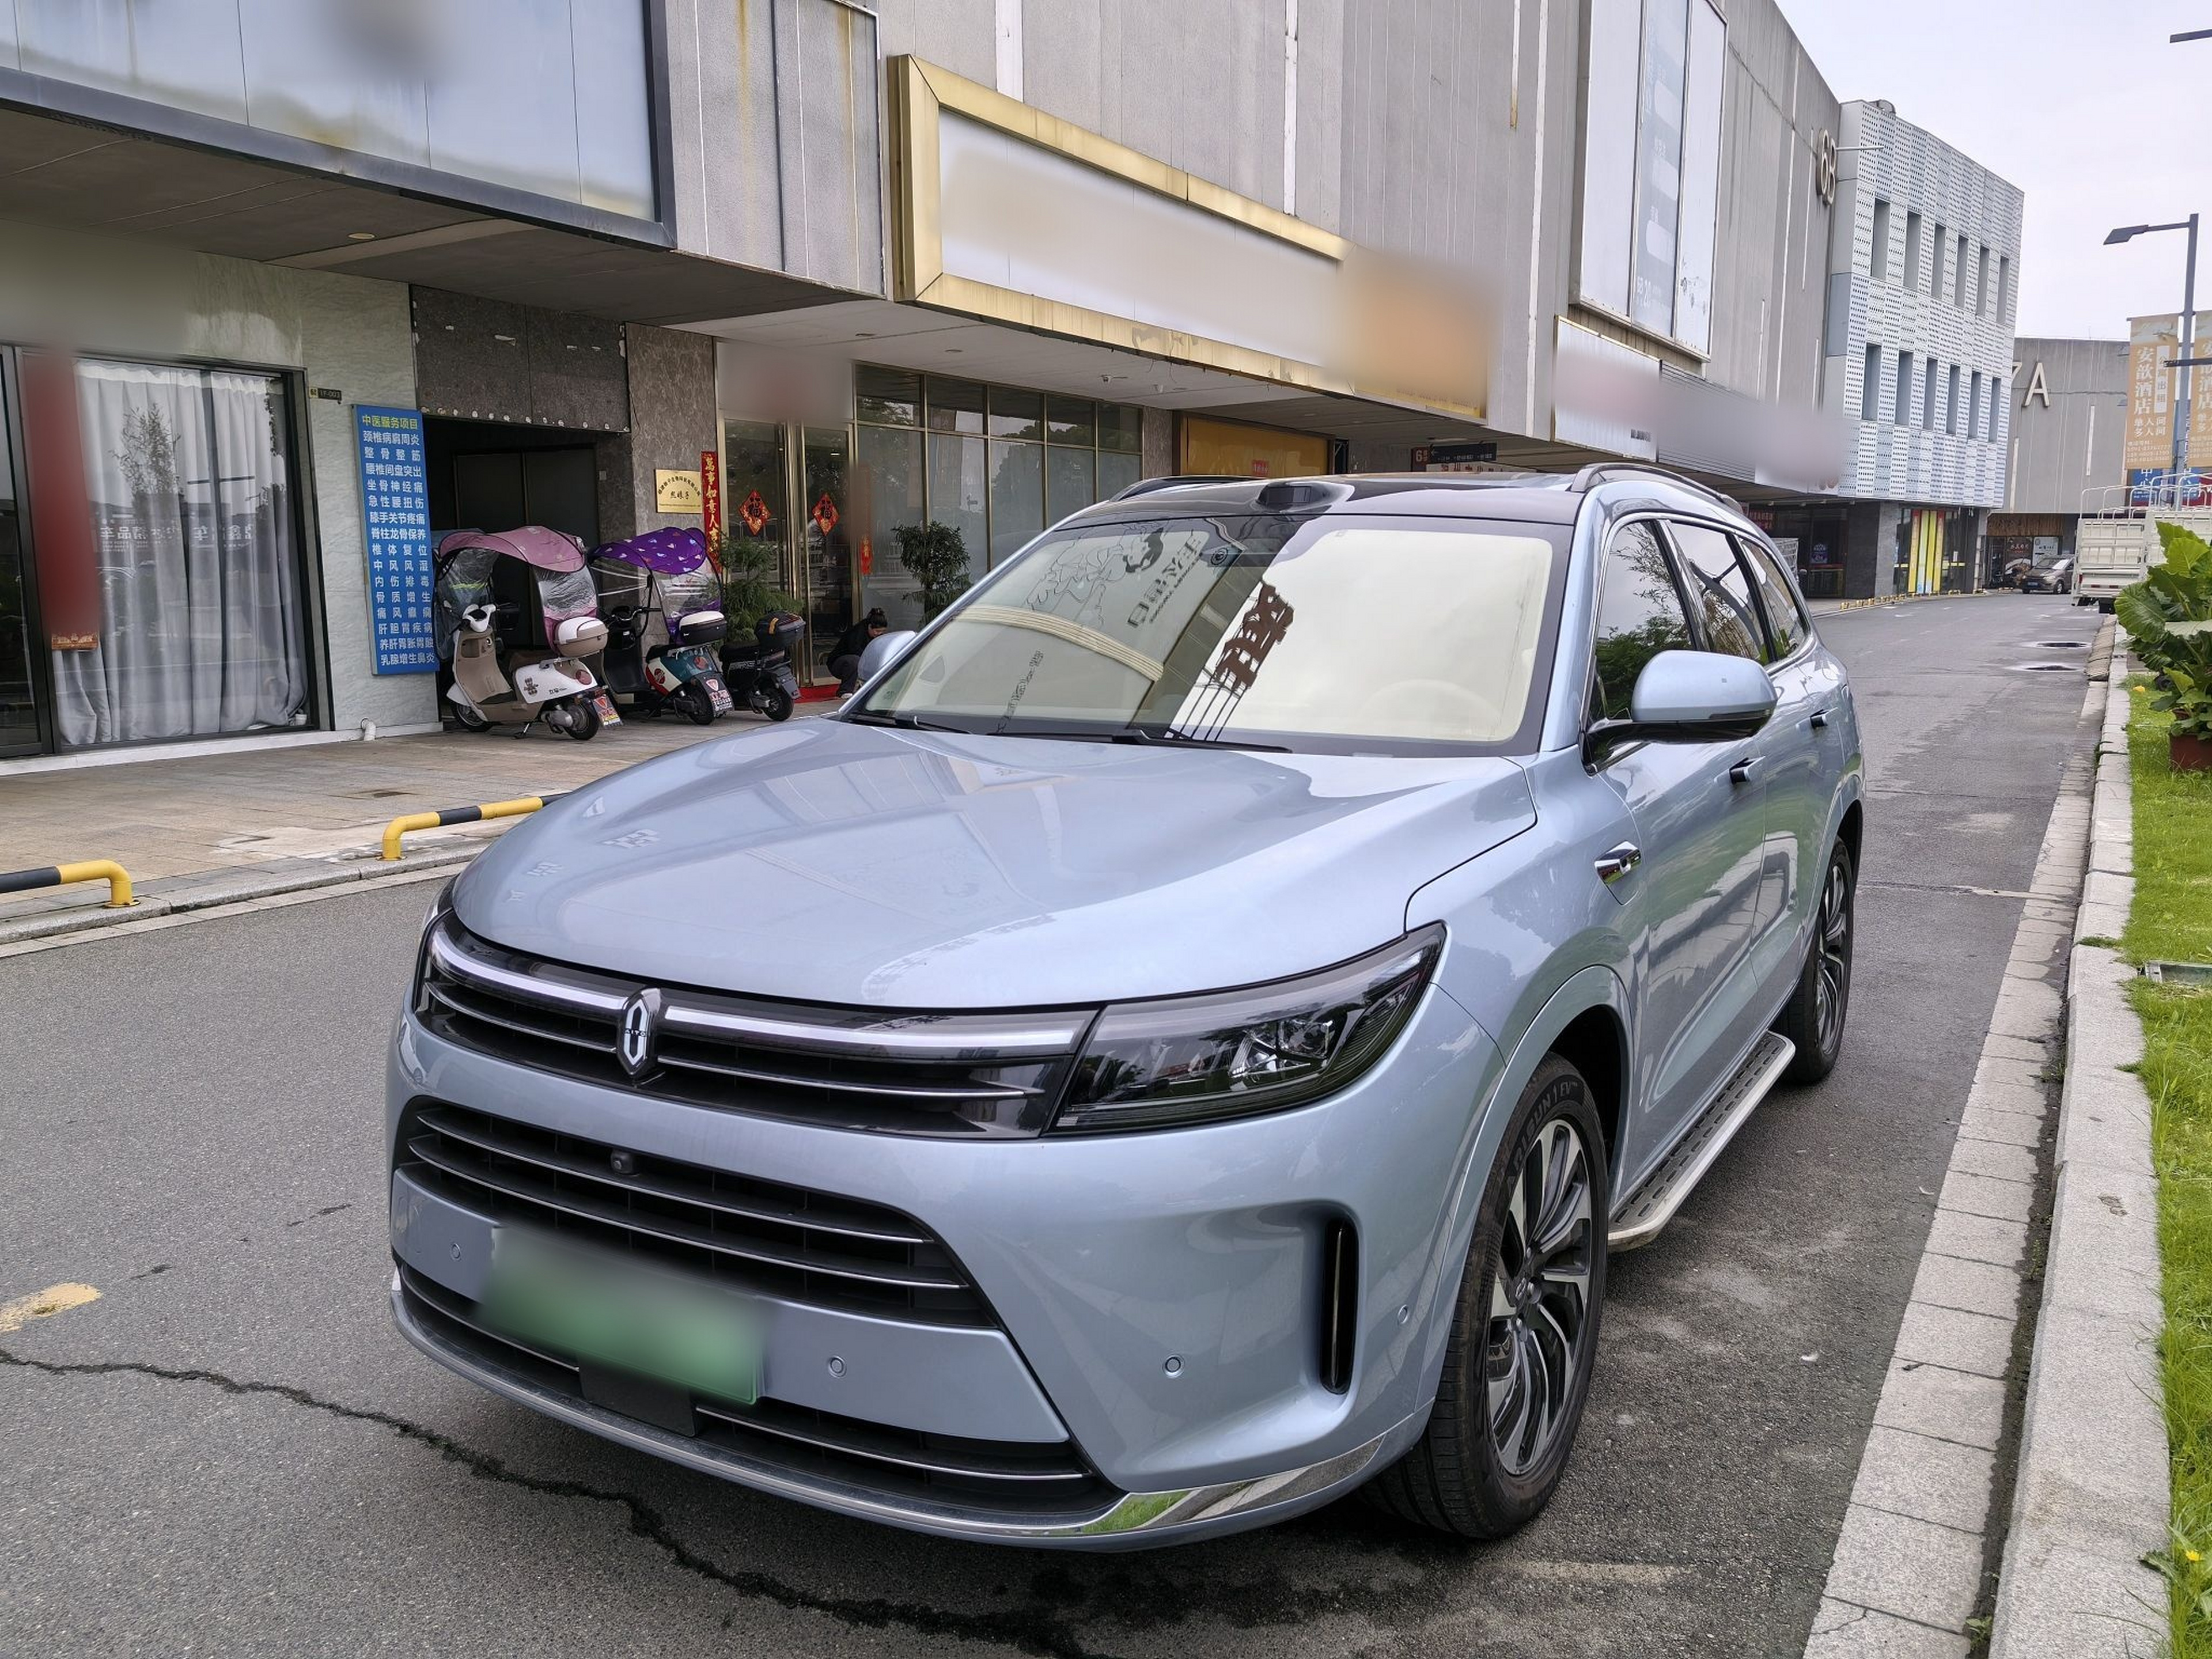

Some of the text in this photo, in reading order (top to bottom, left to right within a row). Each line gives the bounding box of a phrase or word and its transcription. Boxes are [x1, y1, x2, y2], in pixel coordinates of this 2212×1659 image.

[362, 414, 418, 430] 中医服务项目
[363, 430, 420, 446] 颈椎病肩周炎
[364, 446, 421, 461] 整骨整筋
[365, 463, 422, 478] 腰椎间盘突出
[367, 478, 423, 493] 坐骨神经痛
[368, 495, 424, 509] 急性腰扭伤
[748, 497, 762, 518] 福
[369, 512, 425, 525] 膝手关节疼痛
[371, 527, 426, 540] 脊柱龙骨保养
[372, 543, 427, 556] 椎体复位
[373, 559, 429, 572] 中风风湿
[374, 575, 430, 588] 内伤排毒
[376, 591, 431, 604] 骨质增生
[624, 1028, 646, 1037] AITO
